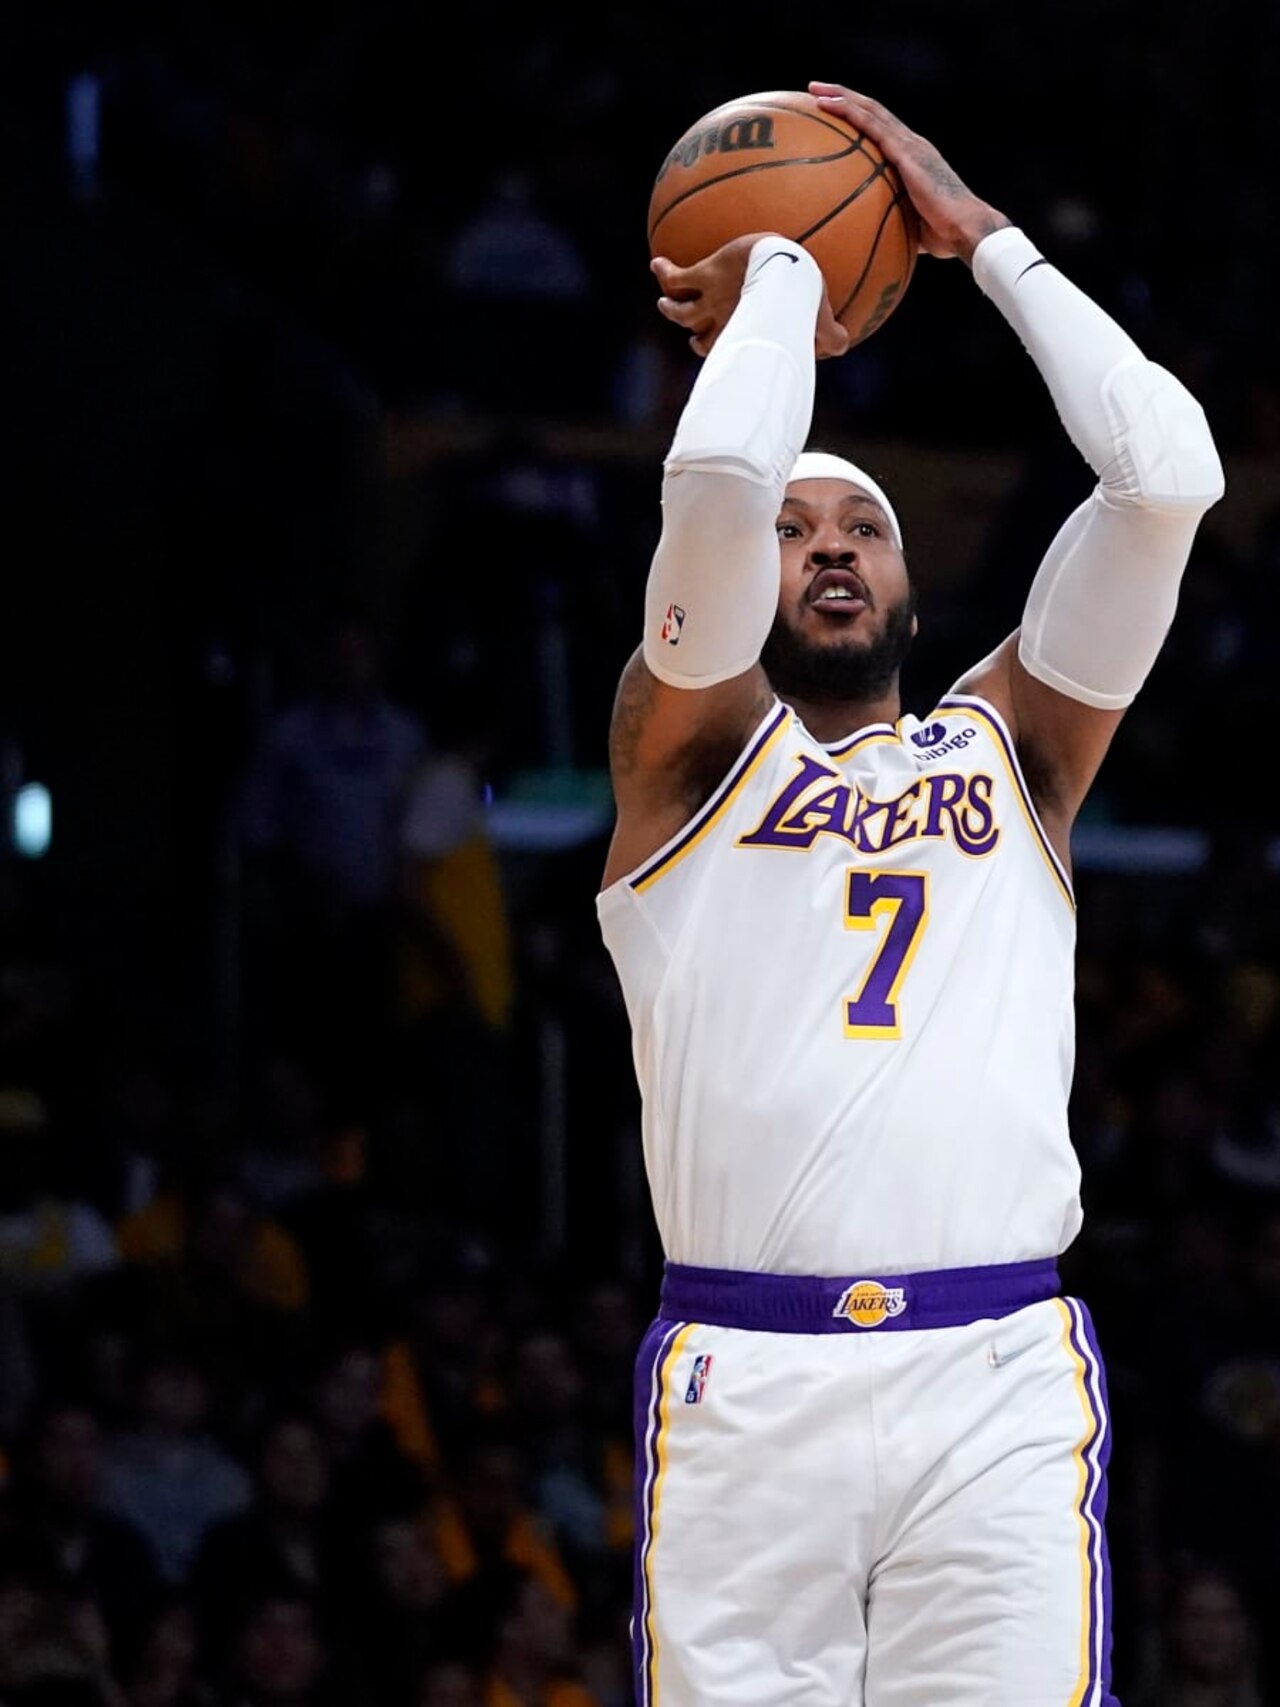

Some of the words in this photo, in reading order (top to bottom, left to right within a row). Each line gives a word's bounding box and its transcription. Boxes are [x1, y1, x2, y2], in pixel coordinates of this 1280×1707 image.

[912, 727, 977, 761] bibigo
[734, 753, 1003, 859] LAKERS
[844, 868, 930, 1039] 7
[835, 1291, 905, 1316] LAKERS
